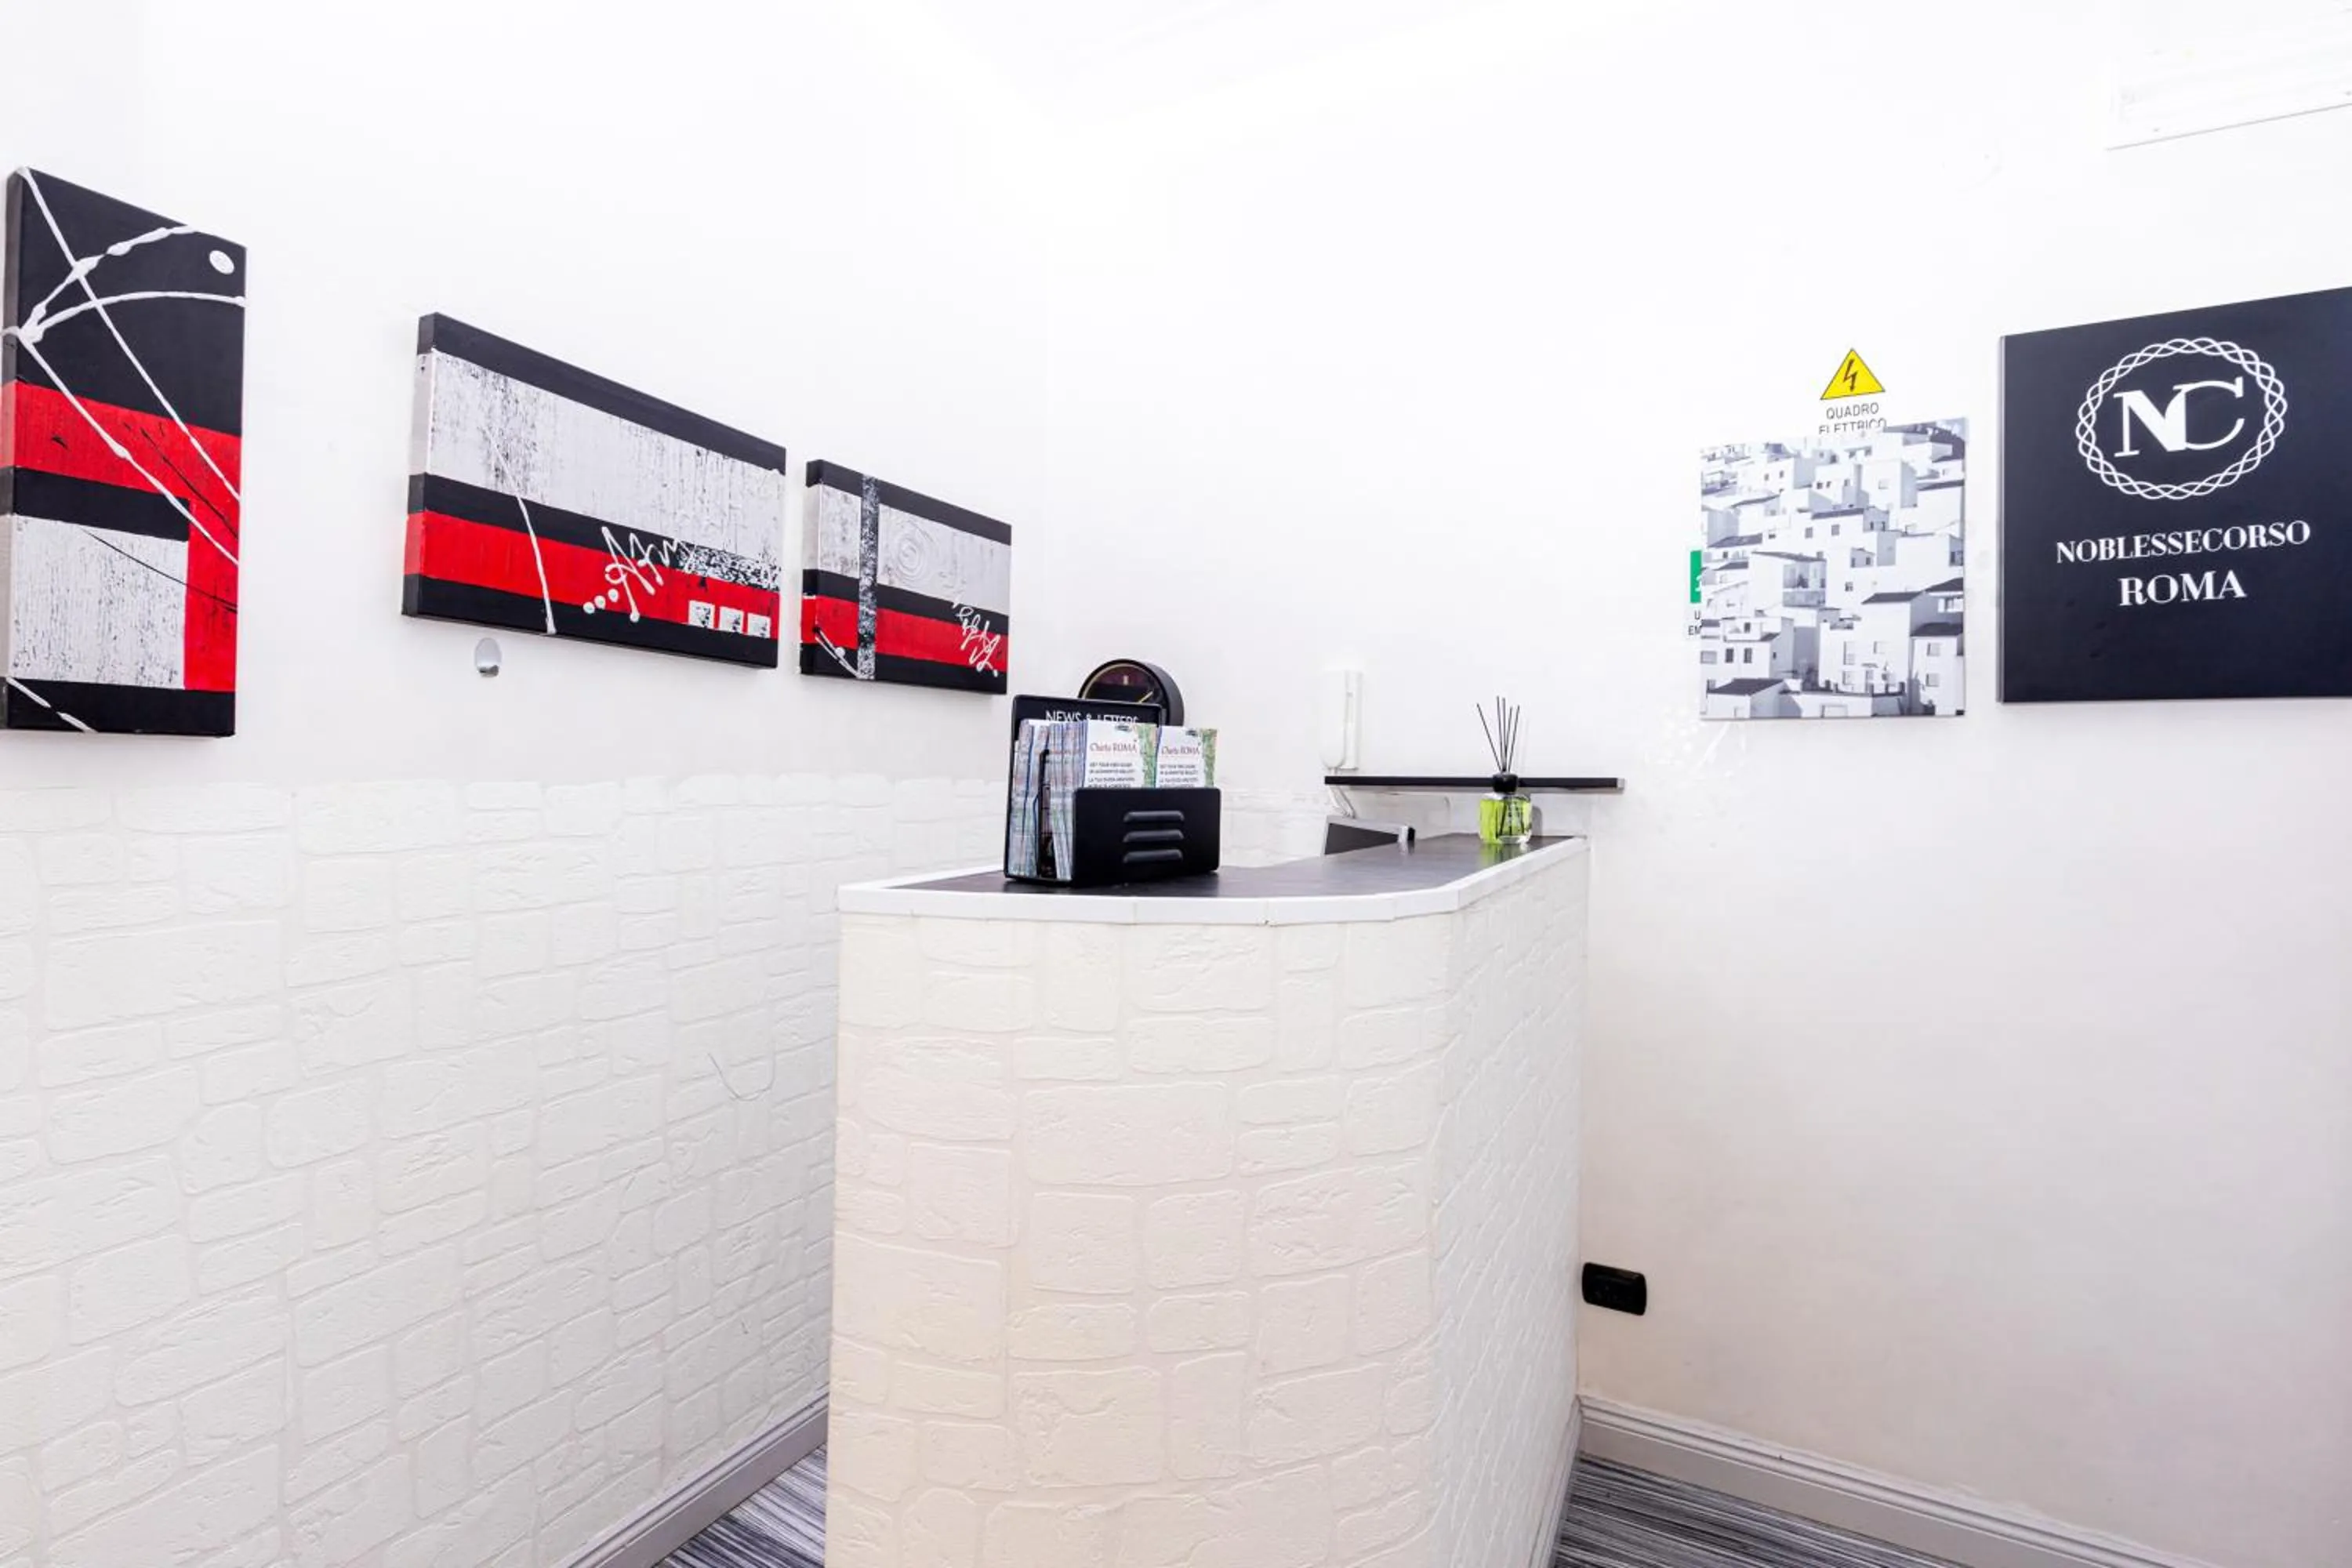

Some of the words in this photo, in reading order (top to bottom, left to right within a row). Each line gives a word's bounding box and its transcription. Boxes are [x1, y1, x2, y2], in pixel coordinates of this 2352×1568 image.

[1826, 401, 1879, 420] QUADRO
[2112, 375, 2246, 458] NC
[1818, 417, 1887, 435] ELETTRICO
[2055, 520, 2311, 564] NOBLESSECORSO
[2118, 569, 2248, 607] ROMA
[1045, 710, 1082, 722] NEWS
